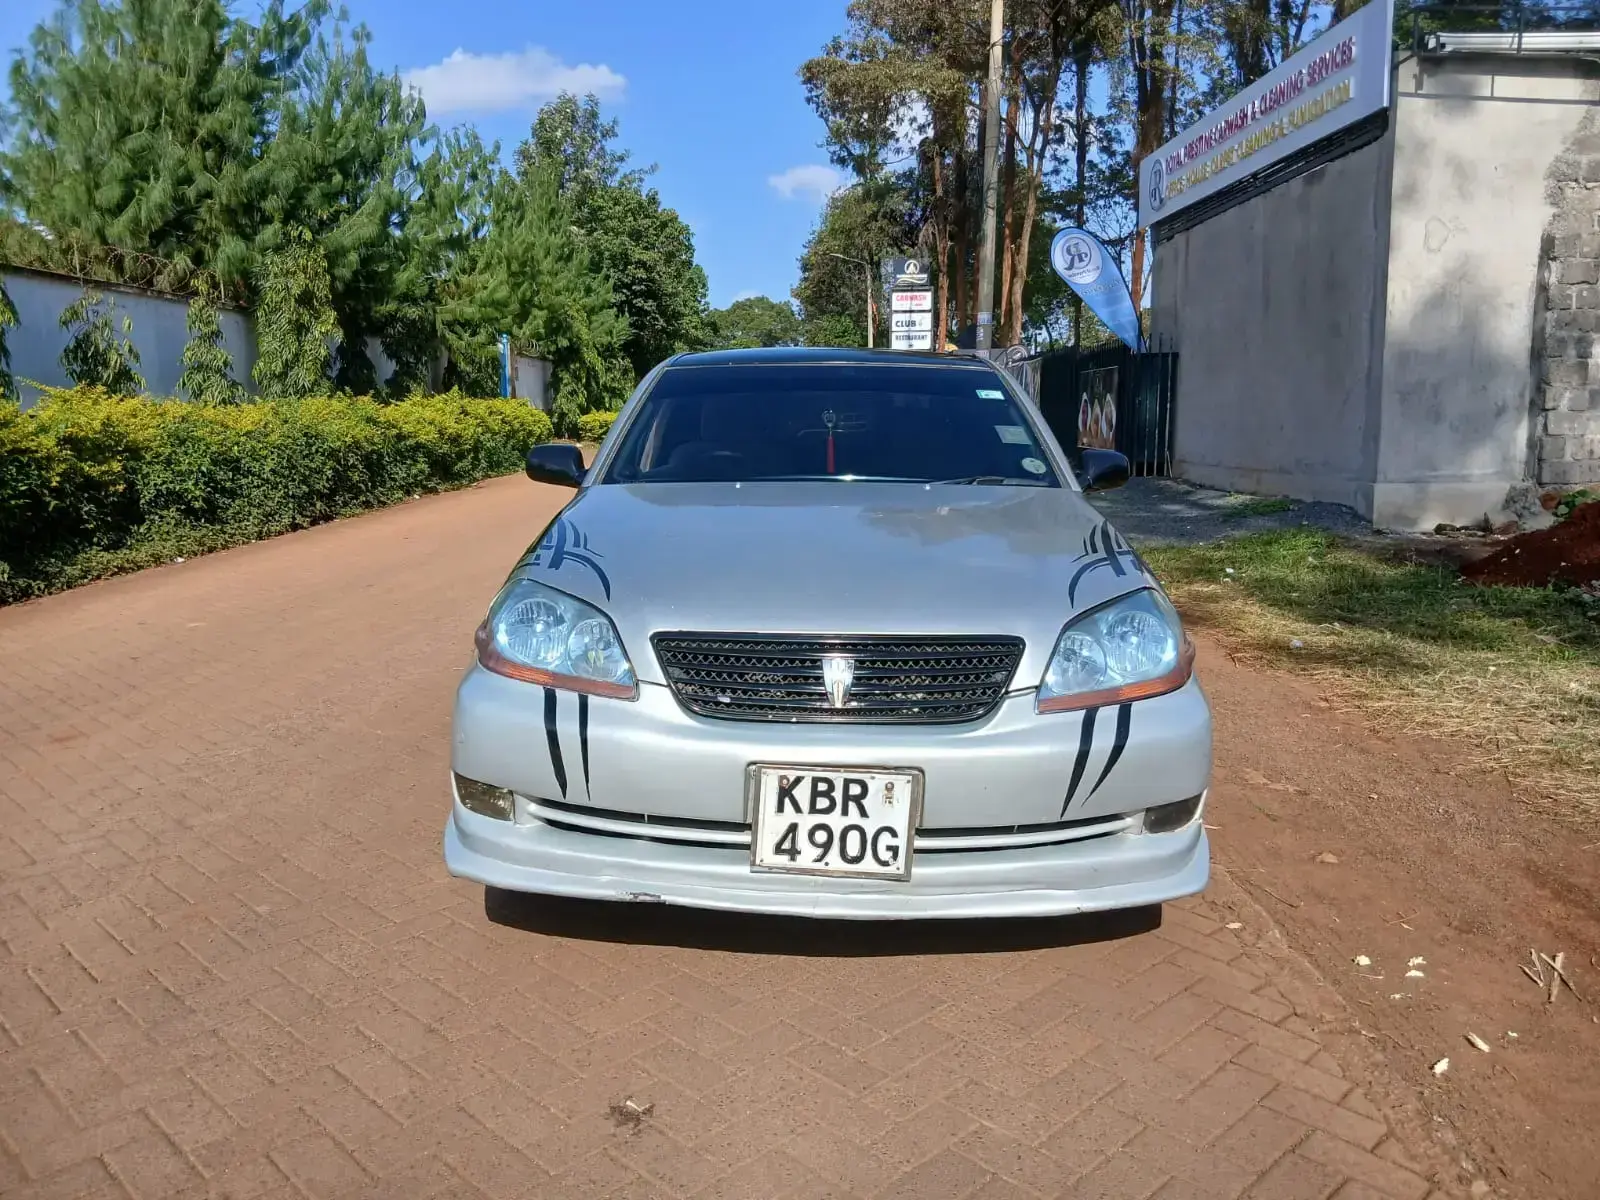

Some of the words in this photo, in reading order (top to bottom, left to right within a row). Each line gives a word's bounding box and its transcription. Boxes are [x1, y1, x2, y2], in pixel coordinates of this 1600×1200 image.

[1260, 66, 1304, 116] CLEANING
[1306, 36, 1355, 87] SERVICES
[895, 320, 917, 328] CLUB
[776, 775, 870, 818] KBR
[774, 822, 900, 867] 490G
